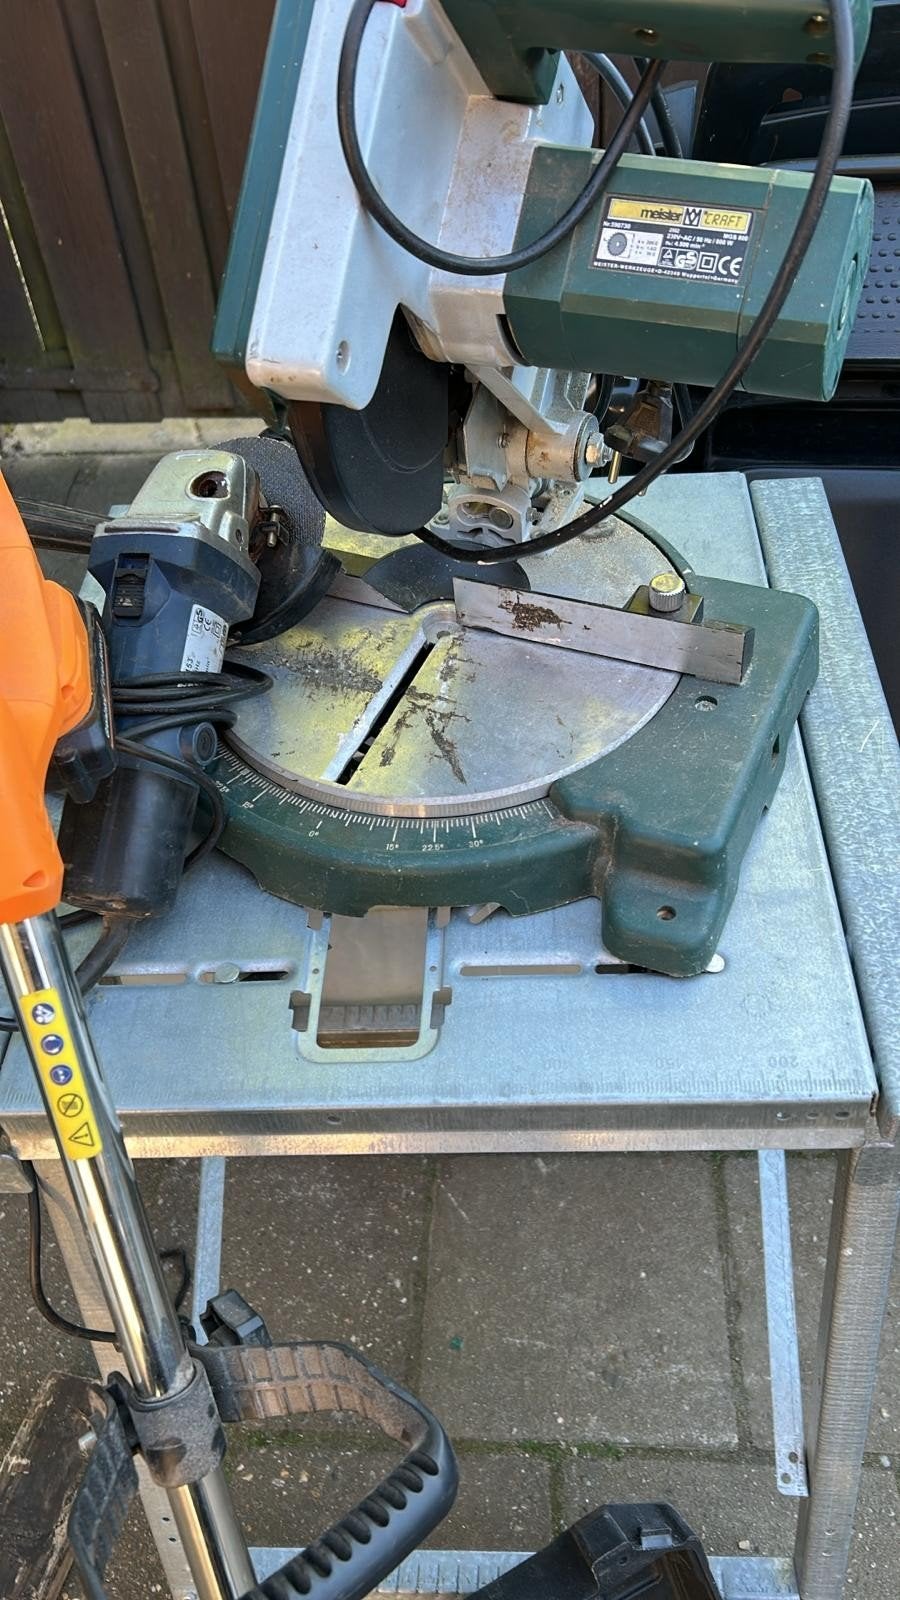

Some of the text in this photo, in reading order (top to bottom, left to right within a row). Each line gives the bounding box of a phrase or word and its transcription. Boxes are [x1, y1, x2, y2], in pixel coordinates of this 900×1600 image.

[640, 208, 742, 227] meister CRAFT
[677, 251, 698, 268] GS
[718, 255, 742, 276] CE
